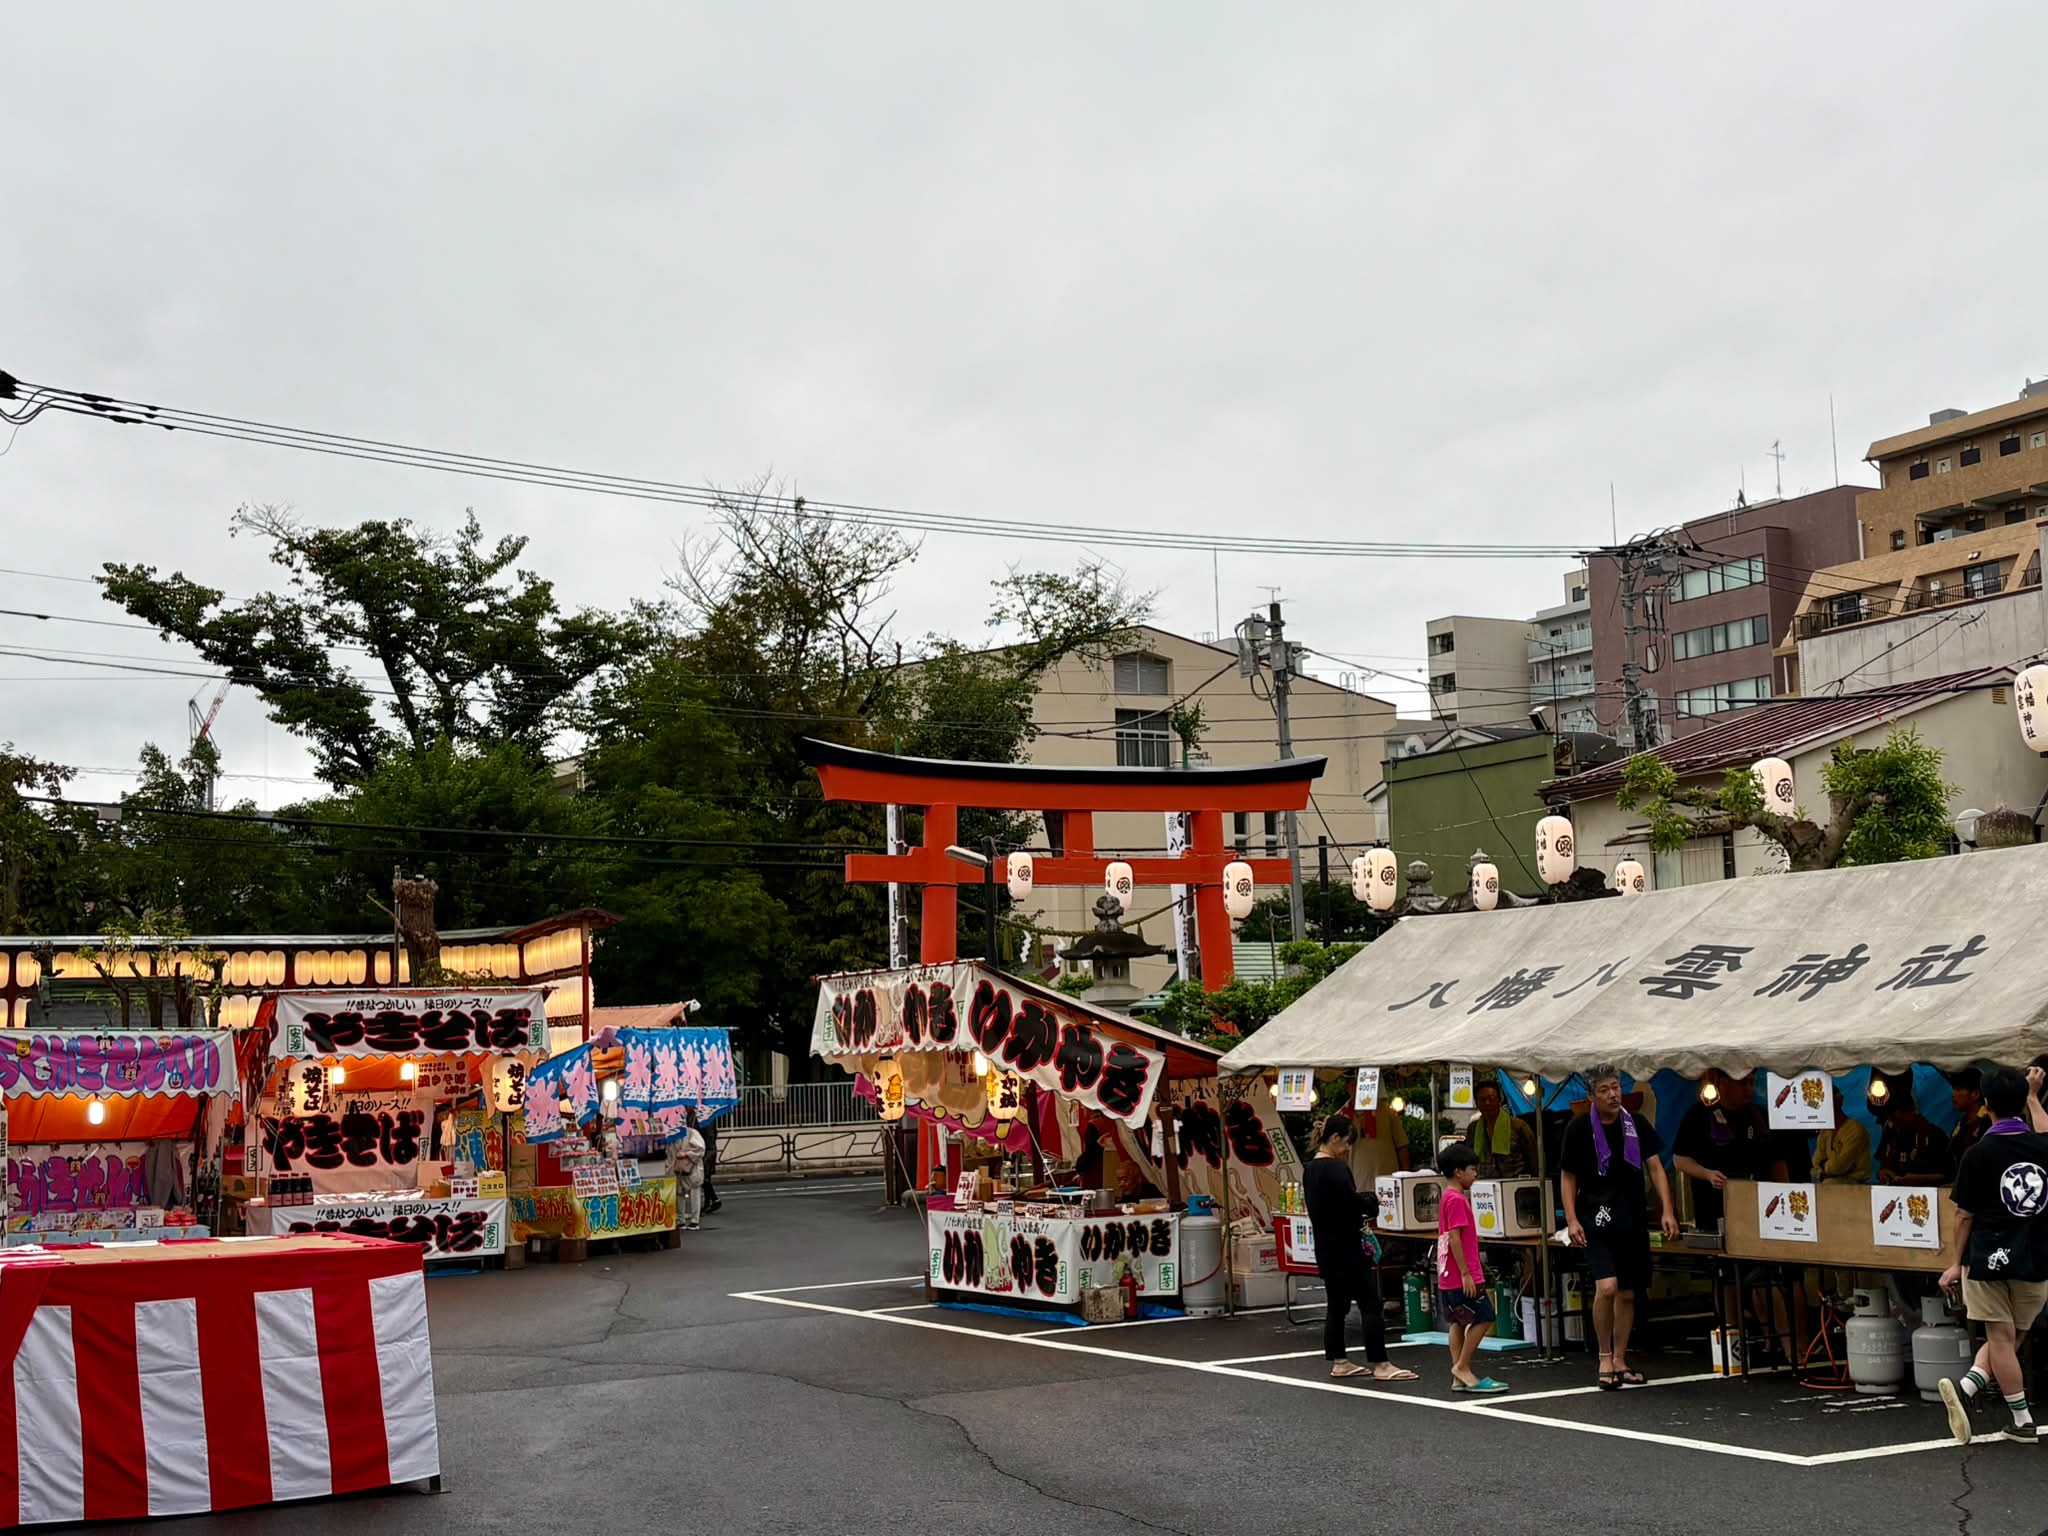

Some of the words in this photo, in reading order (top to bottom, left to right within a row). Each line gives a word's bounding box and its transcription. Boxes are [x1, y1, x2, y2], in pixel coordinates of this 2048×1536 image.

[1387, 934, 1990, 1014] 八幡八雲神社
[302, 1008, 532, 1053] やきそば
[968, 979, 1151, 1117] いかやき
[302, 1065, 323, 1111] 焼そば
[507, 1062, 526, 1106] 焼そば
[262, 1110, 425, 1171] やきそば
[585, 1190, 666, 1233] 冷凍みかん
[1476, 1202, 1494, 1211] 300円
[1080, 1218, 1171, 1262] いかやき
